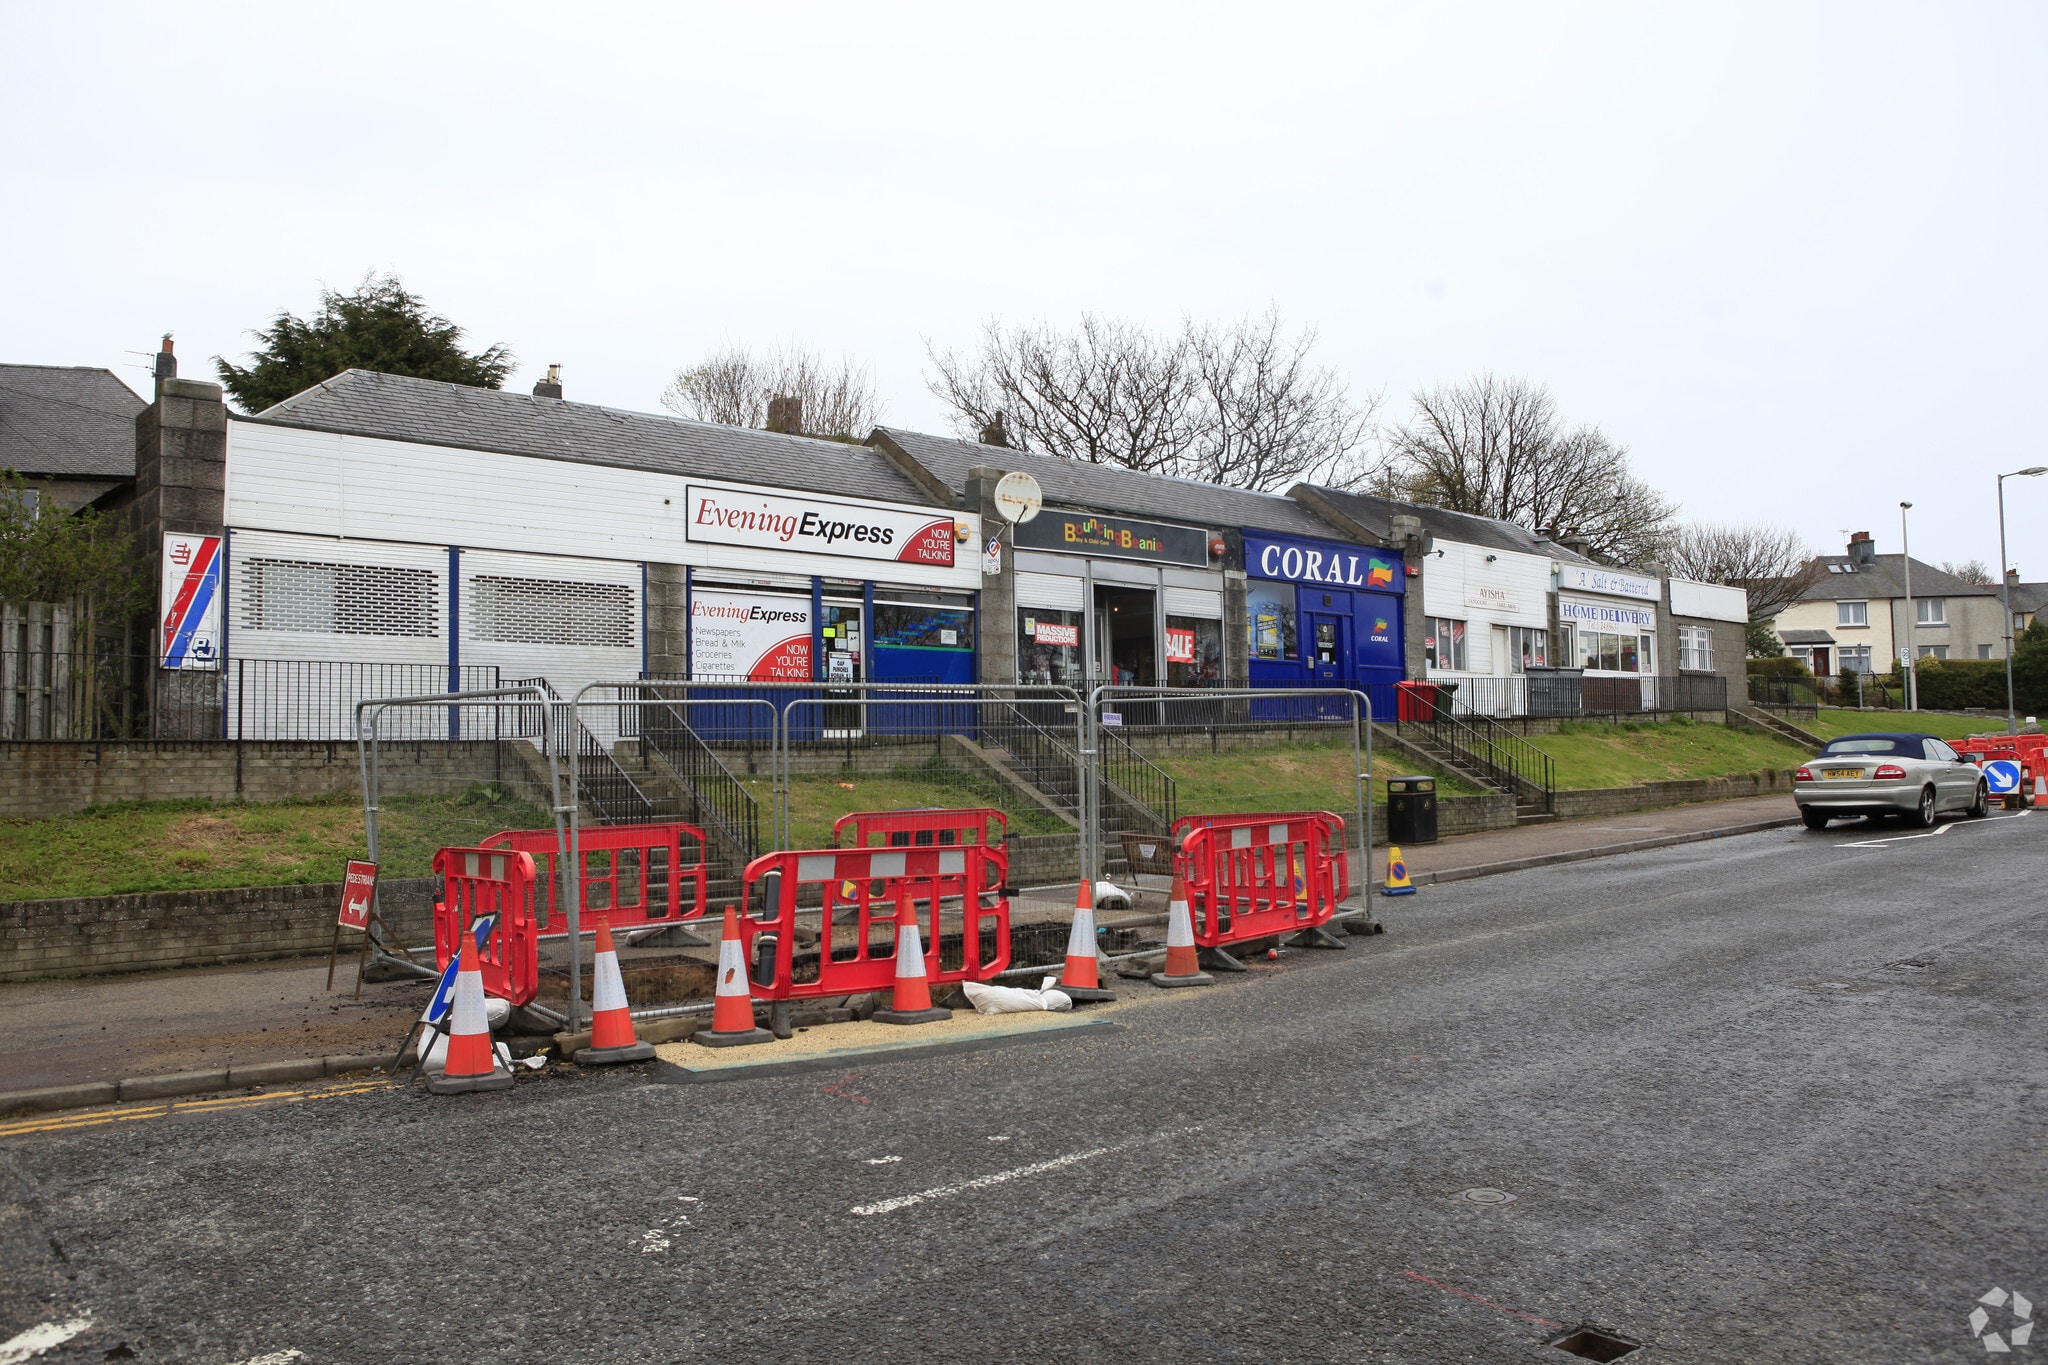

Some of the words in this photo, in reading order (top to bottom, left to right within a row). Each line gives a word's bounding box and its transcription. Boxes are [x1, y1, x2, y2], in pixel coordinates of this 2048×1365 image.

[694, 497, 798, 542] Evening
[798, 511, 894, 545] Express
[931, 528, 950, 539] NOW
[922, 539, 950, 551] YOU'RE
[917, 548, 951, 561] TALKING
[1261, 545, 1363, 586] CORAL
[1592, 573, 1607, 589] Salt
[1610, 577, 1618, 591] &
[1619, 578, 1650, 596] Battered
[1479, 588, 1505, 600] AYISHA
[691, 600, 750, 624] Evening
[749, 606, 807, 624] Express
[1563, 604, 1597, 620] HOME
[1600, 608, 1651, 625] DELIVERY
[695, 626, 741, 637] Newspapers
[1036, 625, 1076, 637] MASSIVE
[695, 638, 719, 648] Bread
[721, 639, 728, 648] &
[731, 639, 746, 648] Milk
[1036, 634, 1076, 644] REDUCTIONS
[1370, 635, 1389, 643] CORAL
[786, 644, 809, 655] NOW
[1166, 634, 1192, 658] SALE
[695, 649, 732, 660] Groceries
[695, 661, 735, 672] Cigarettes
[775, 655, 809, 667] YOU'RE
[770, 667, 809, 678] TALKING
